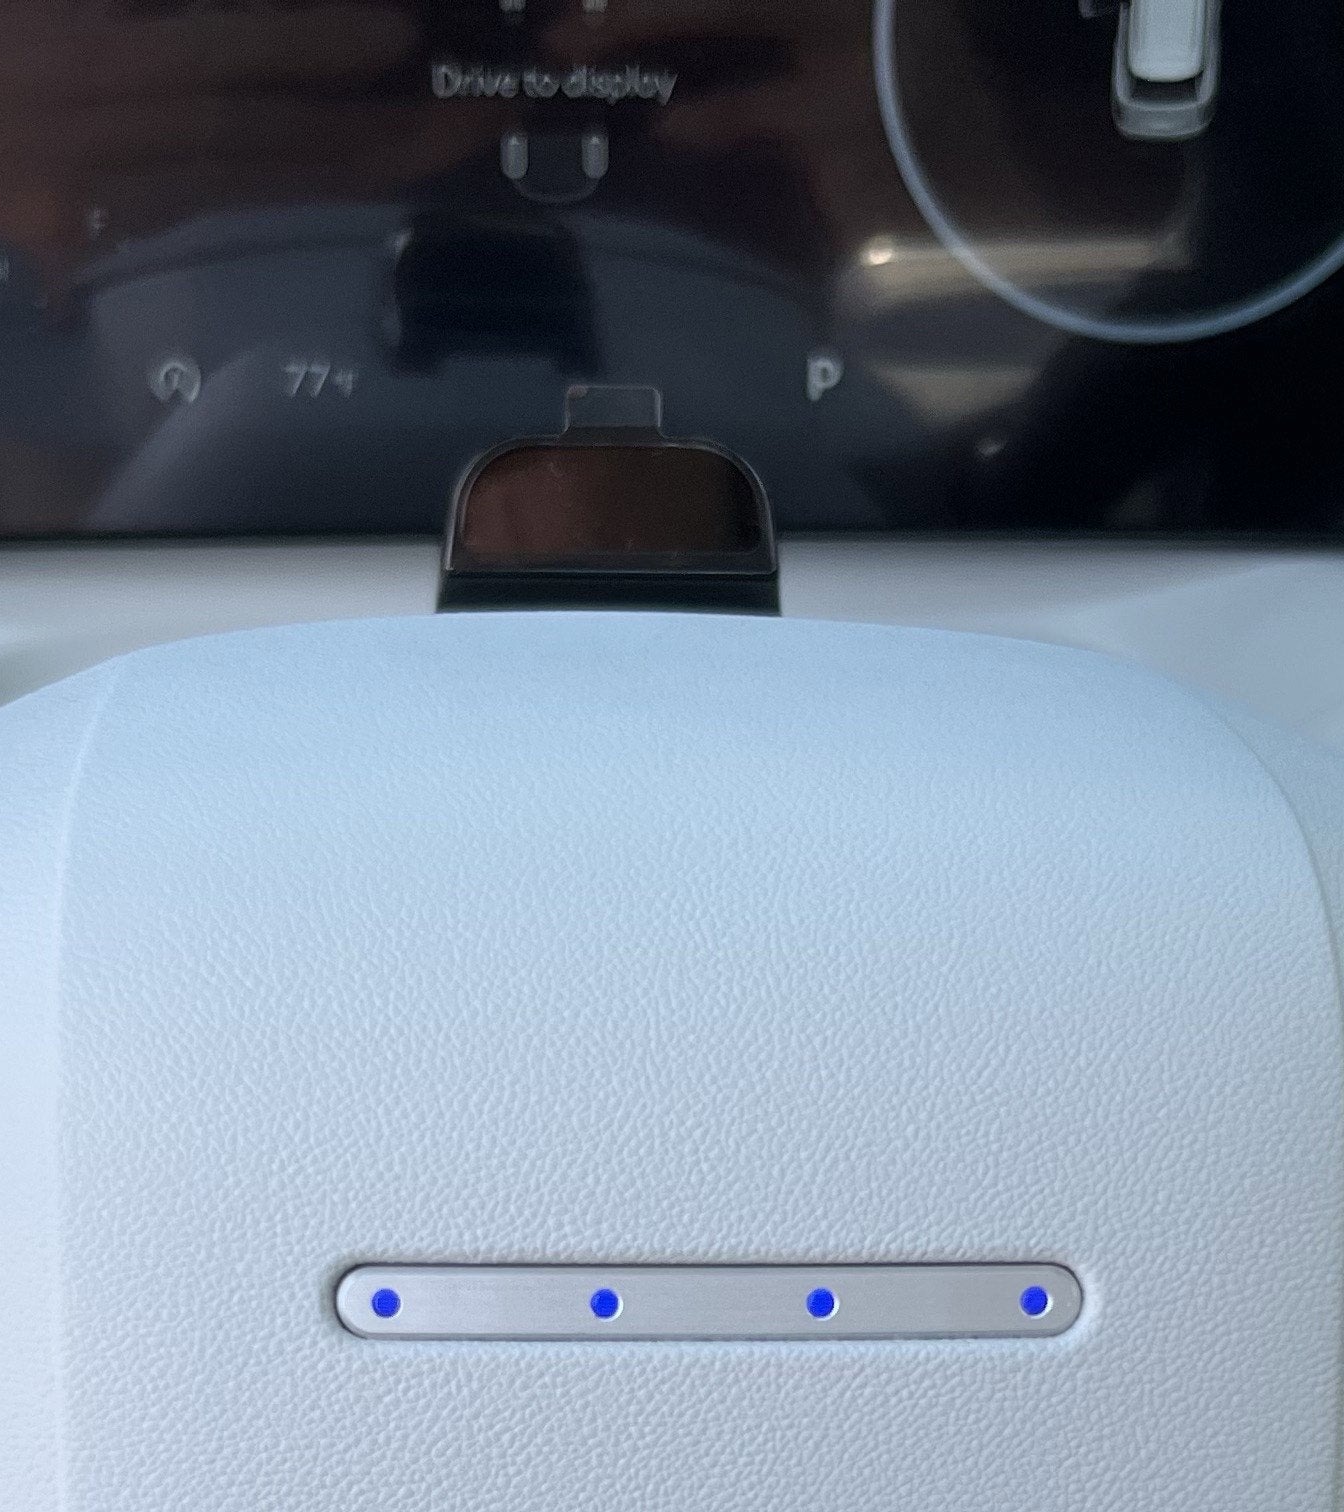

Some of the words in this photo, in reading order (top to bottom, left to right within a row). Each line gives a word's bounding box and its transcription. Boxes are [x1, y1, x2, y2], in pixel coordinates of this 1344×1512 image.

[431, 63, 519, 98] Drive
[522, 66, 559, 98] to
[560, 63, 678, 106] display
[806, 354, 843, 401] P
